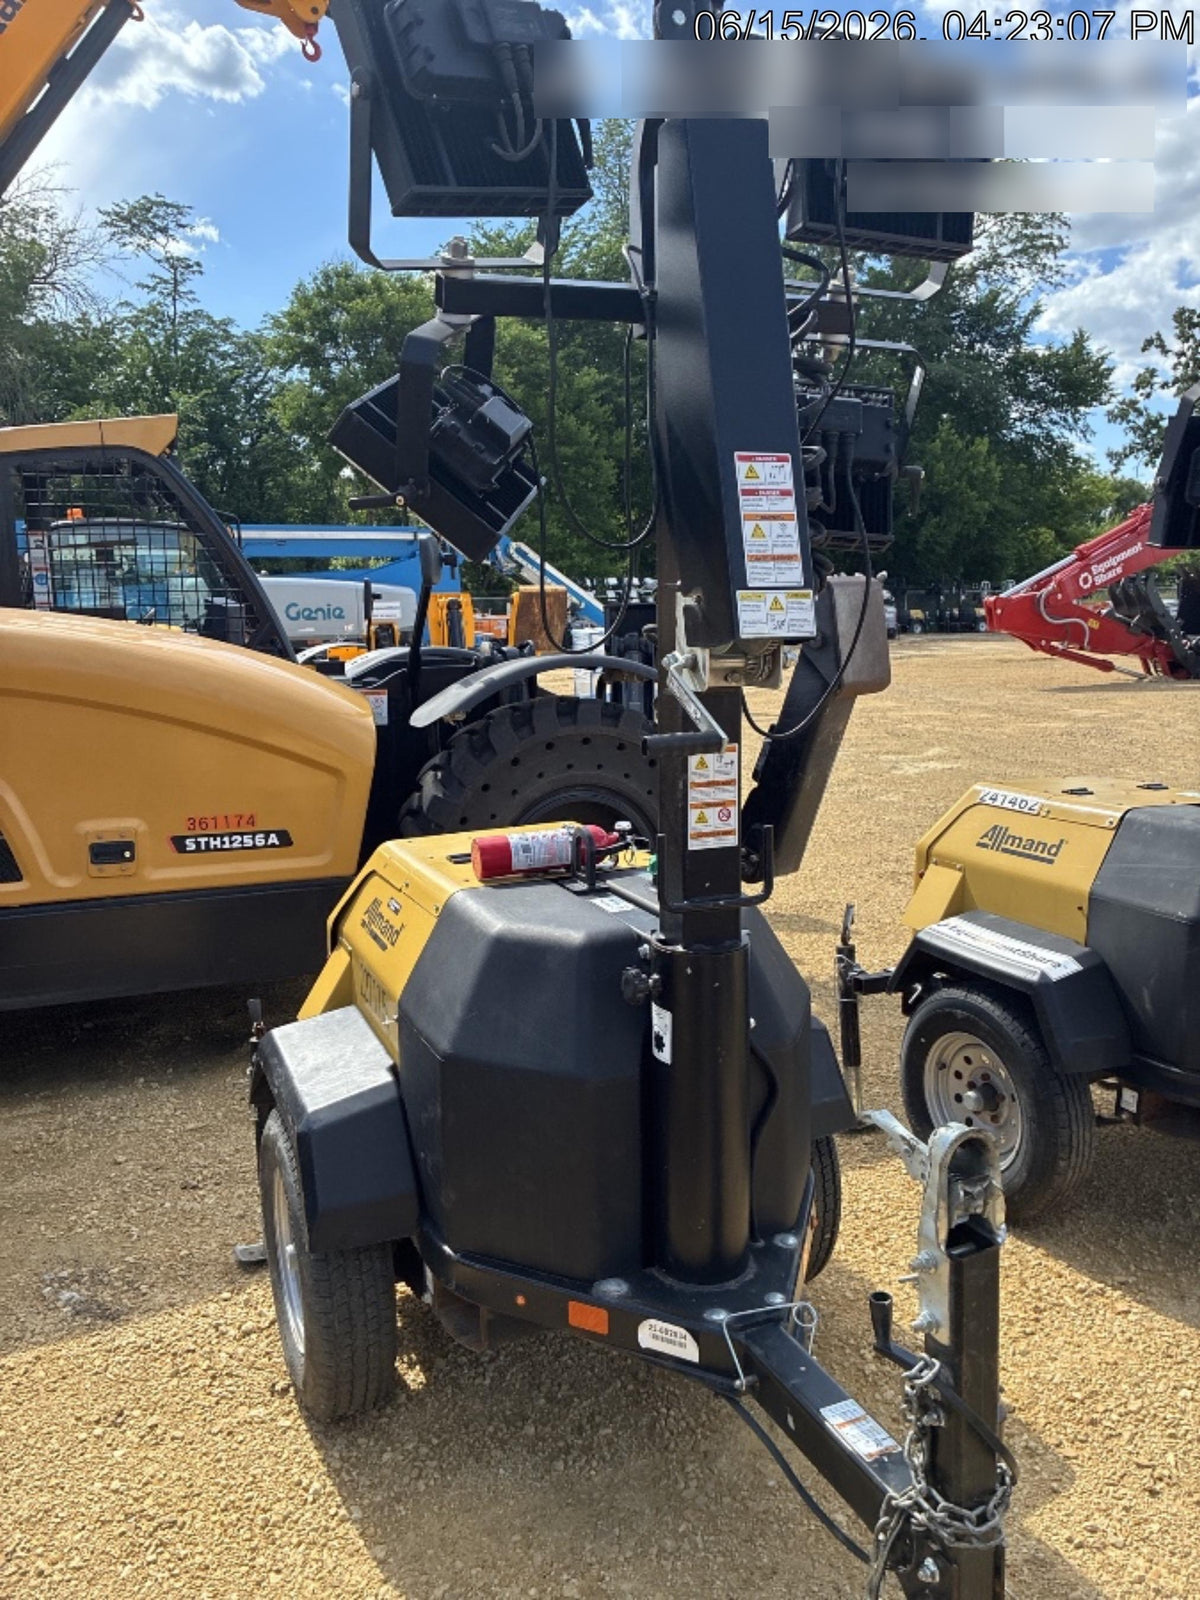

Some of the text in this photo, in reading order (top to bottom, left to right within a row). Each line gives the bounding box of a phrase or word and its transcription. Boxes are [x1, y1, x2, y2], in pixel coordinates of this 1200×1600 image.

[1091, 542, 1143, 576] Equipment
[285, 602, 346, 621] Genie
[187, 814, 256, 831] 361174
[185, 832, 280, 851] STH1256A
[979, 824, 1065, 858] Allmand
